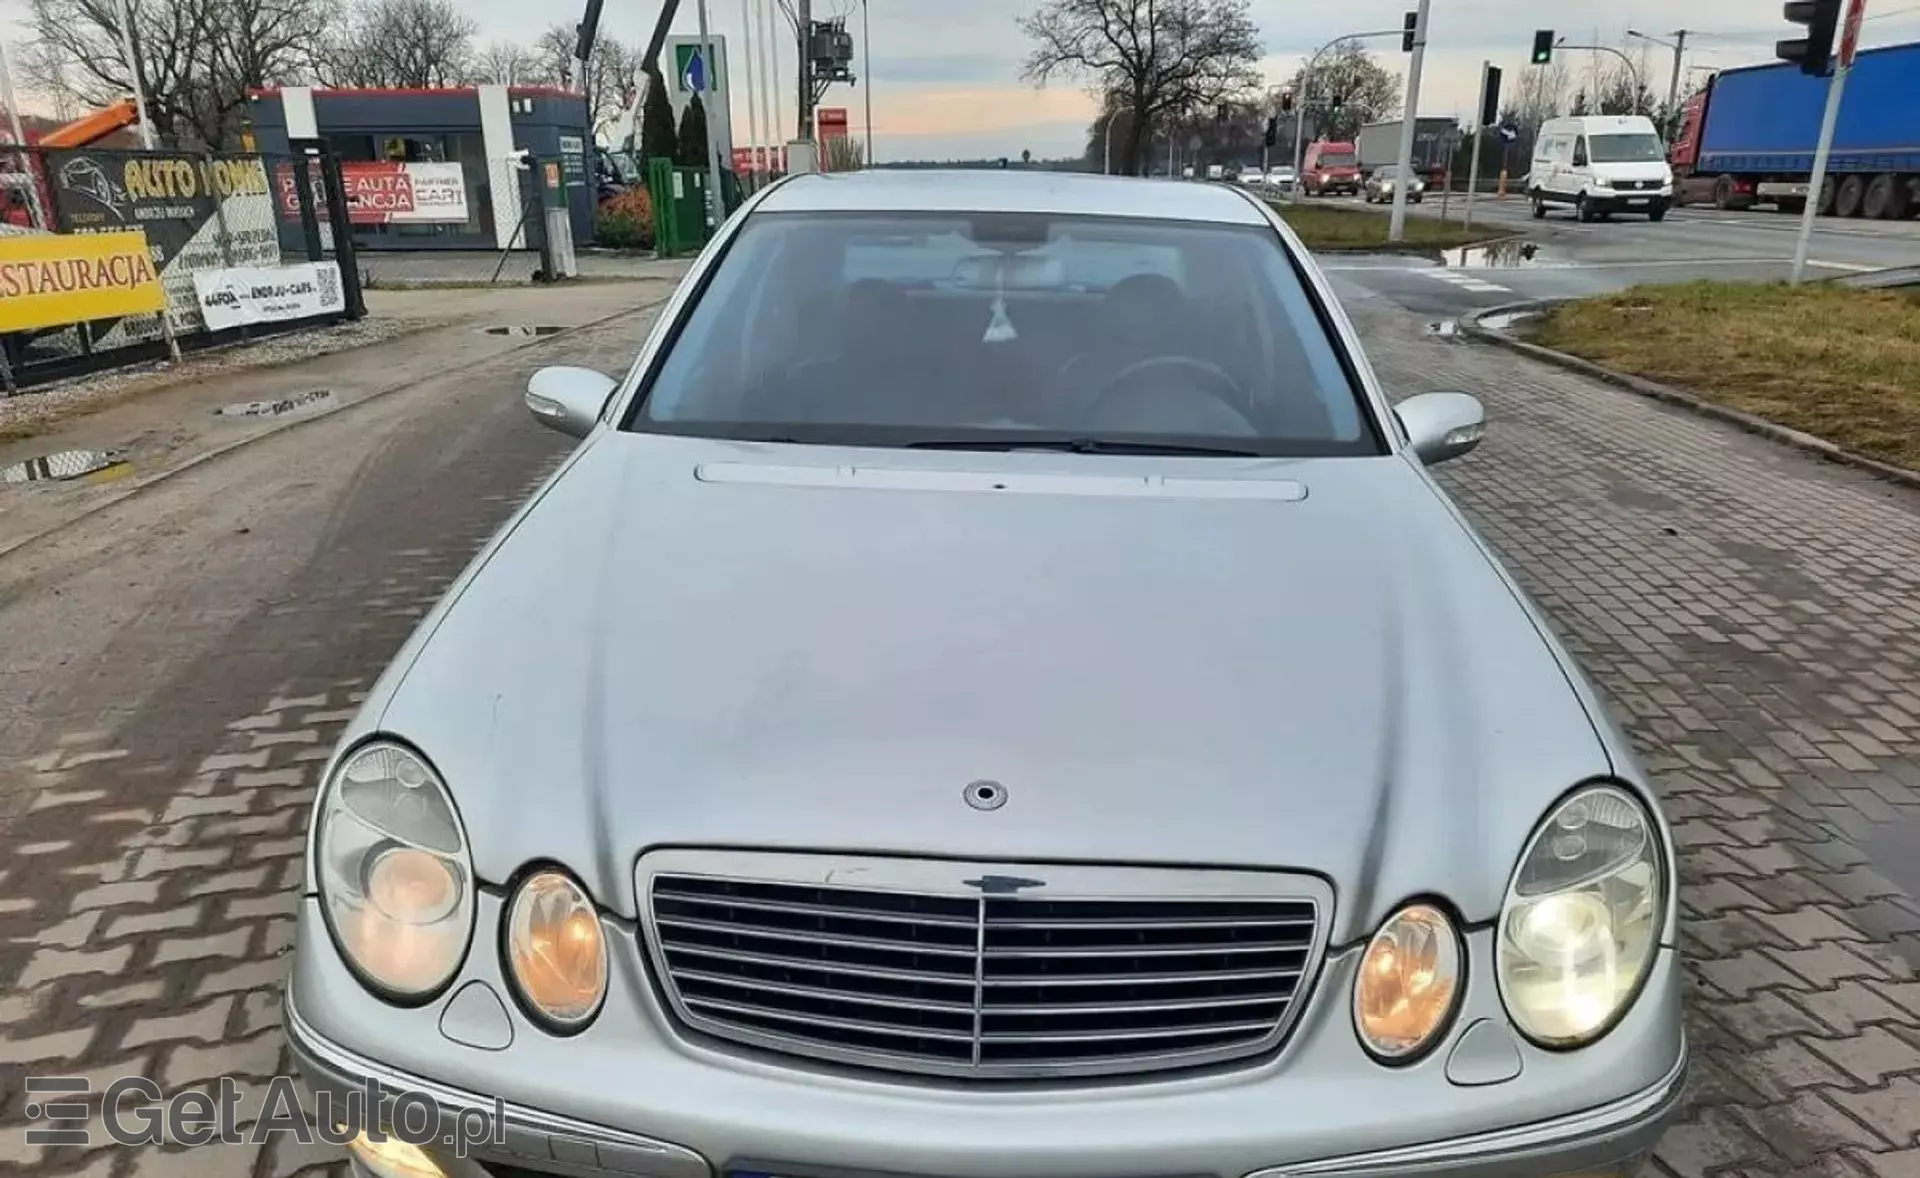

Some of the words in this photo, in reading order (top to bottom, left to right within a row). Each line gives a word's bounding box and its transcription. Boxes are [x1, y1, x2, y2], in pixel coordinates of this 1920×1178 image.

[124, 159, 196, 202] AUTO
[356, 176, 408, 192] AUTA
[0, 254, 153, 298] STAURACJA
